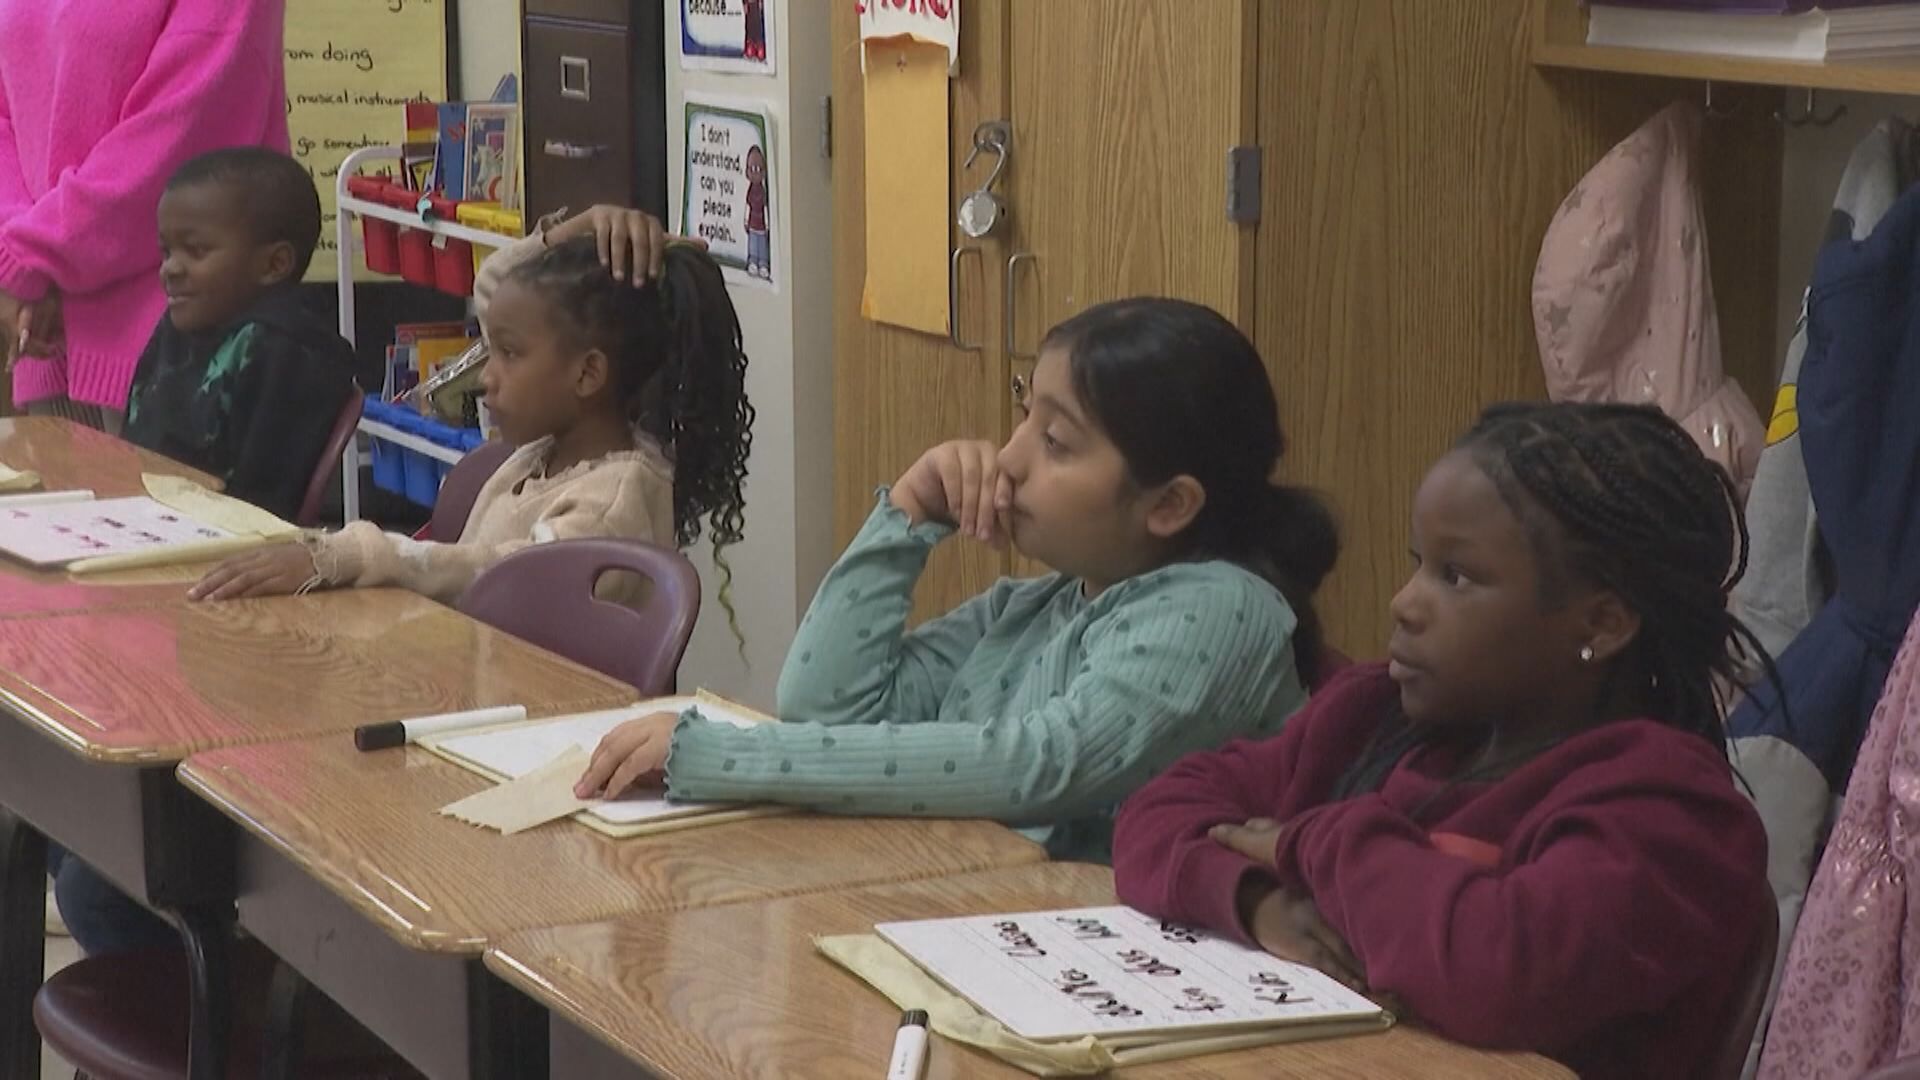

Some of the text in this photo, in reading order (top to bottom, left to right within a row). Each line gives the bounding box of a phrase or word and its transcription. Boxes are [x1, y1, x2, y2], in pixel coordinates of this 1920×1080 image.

[322, 41, 374, 71] doing
[297, 88, 348, 105] musical
[296, 135, 316, 157] go
[701, 124, 730, 147] I don't
[691, 149, 743, 175] understand,
[700, 175, 735, 197] can you
[702, 197, 732, 219] please
